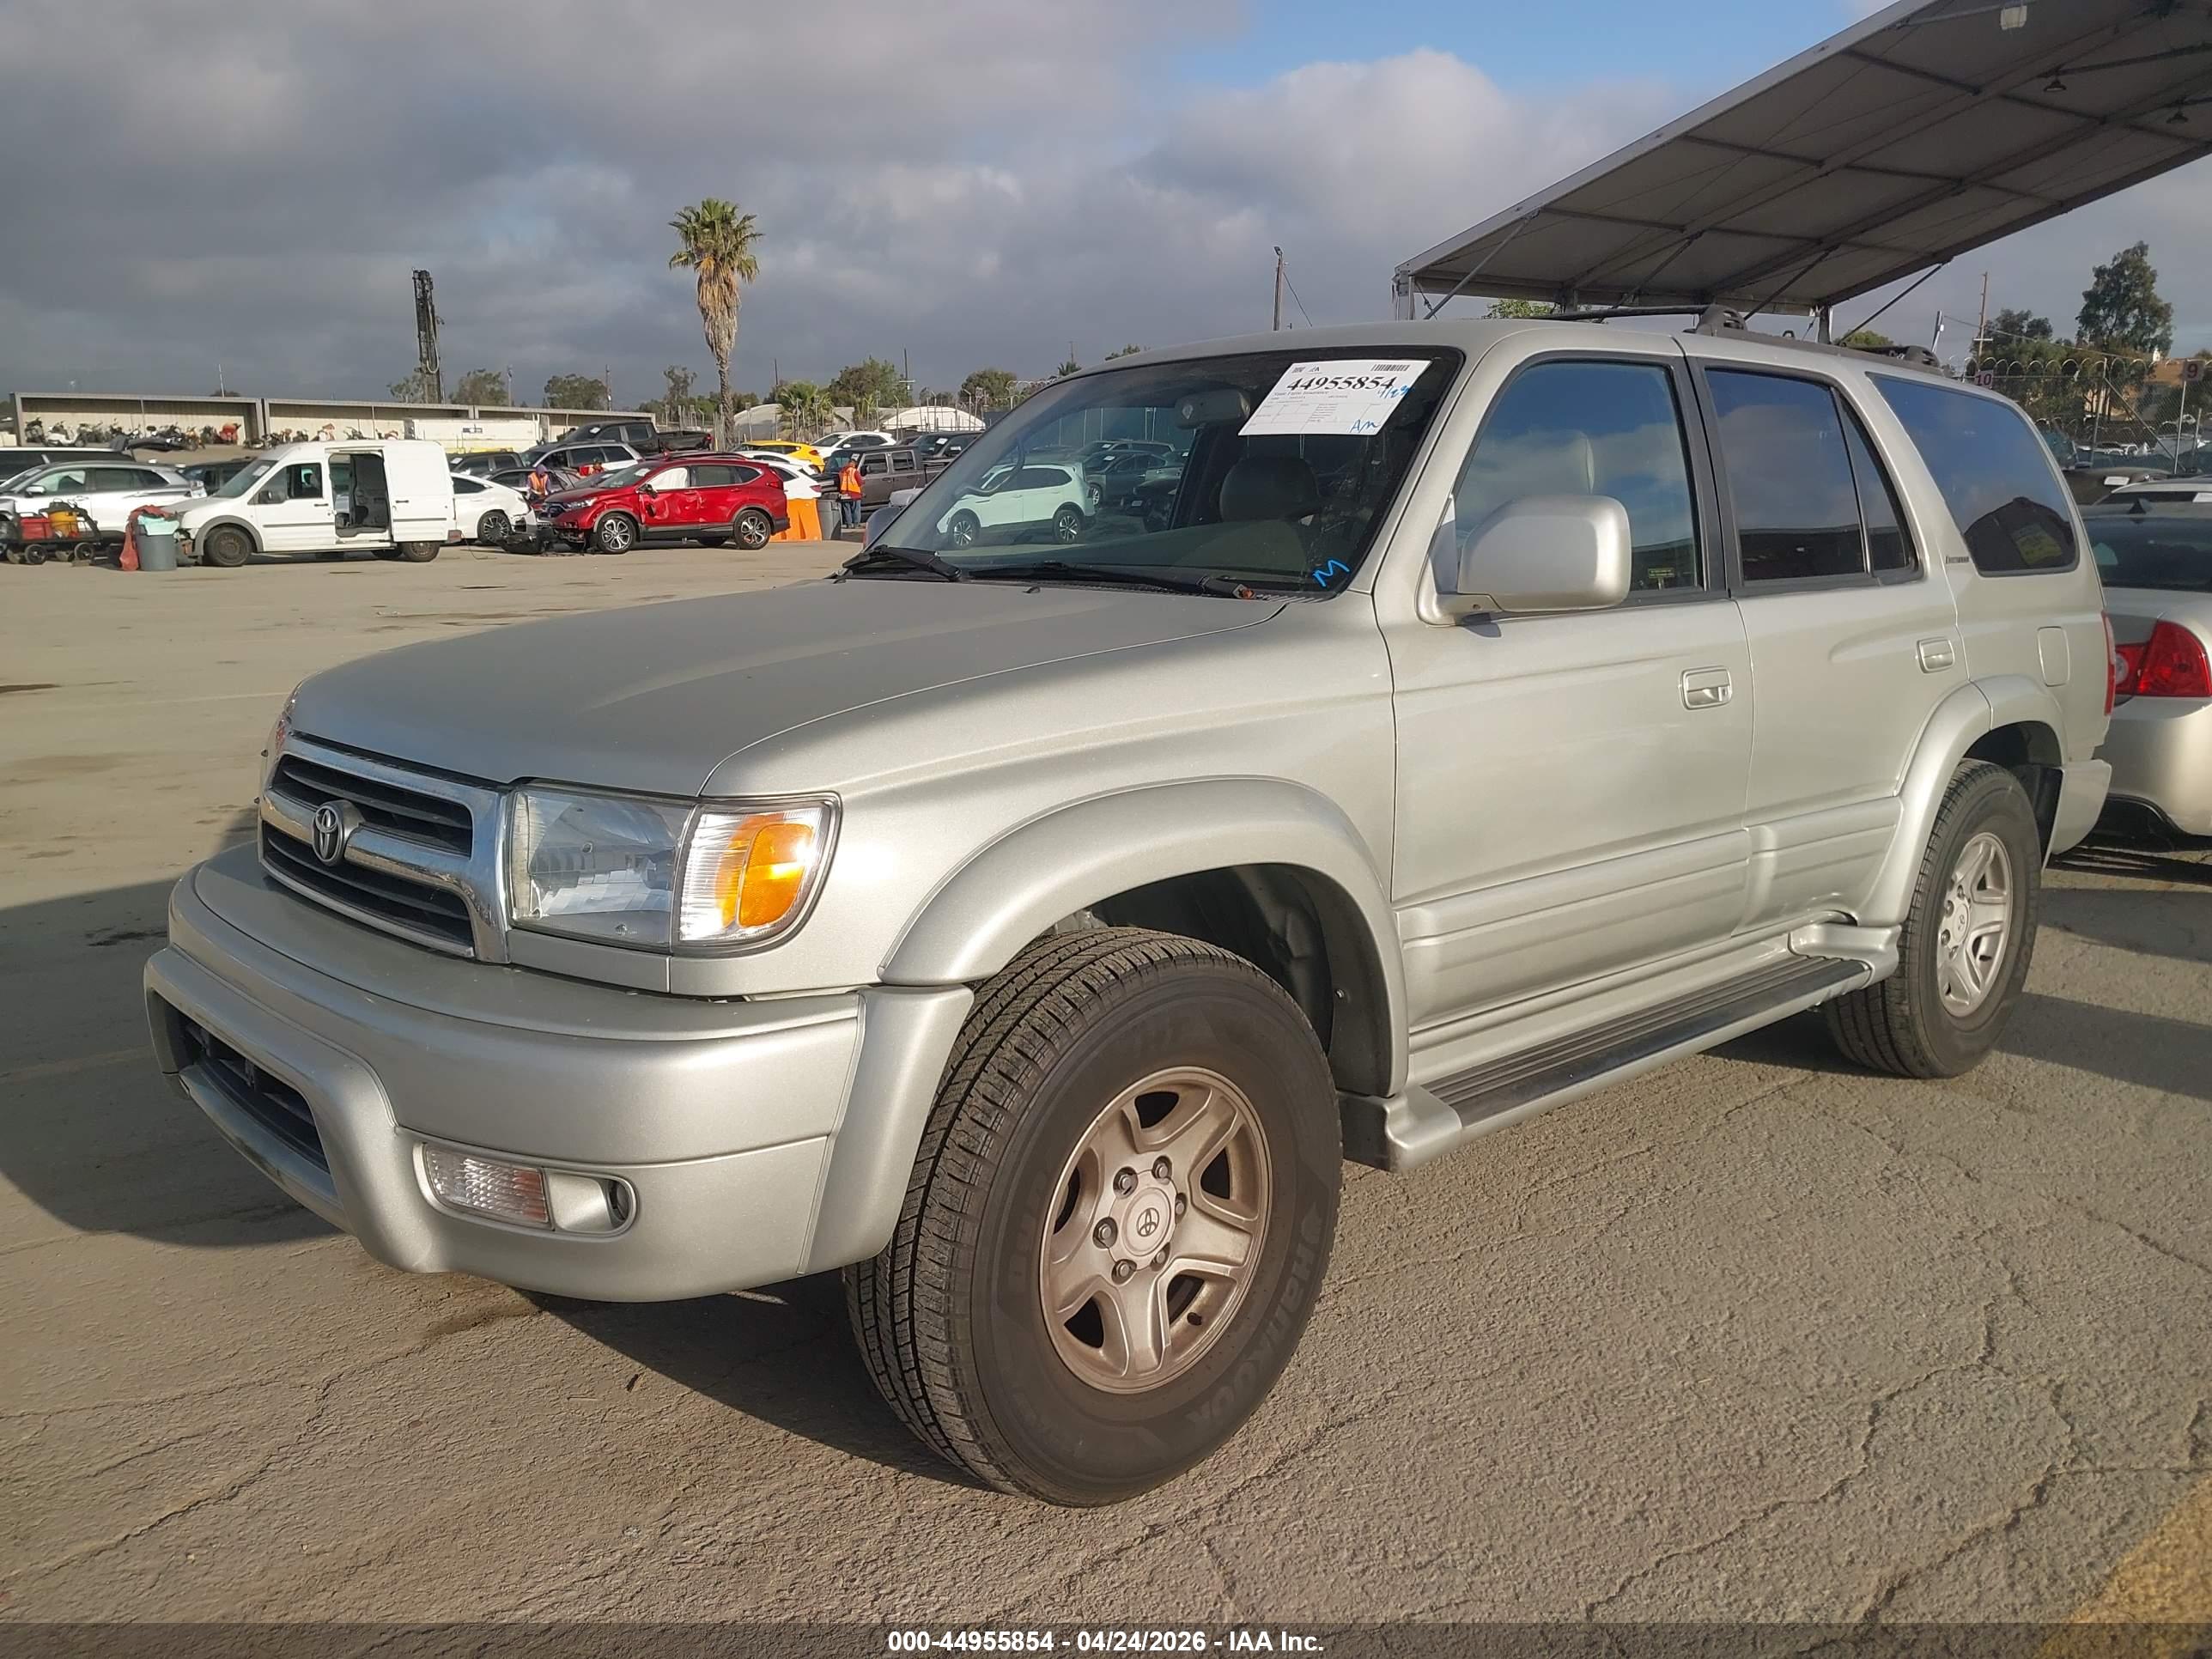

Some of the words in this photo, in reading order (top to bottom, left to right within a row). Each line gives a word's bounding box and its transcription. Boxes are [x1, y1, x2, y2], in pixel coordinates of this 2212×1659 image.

[2187, 363, 2198, 379] 9
[1287, 376, 1398, 391] 44955854
[1975, 373, 1992, 386] 10
[1312, 559, 1351, 587] M
